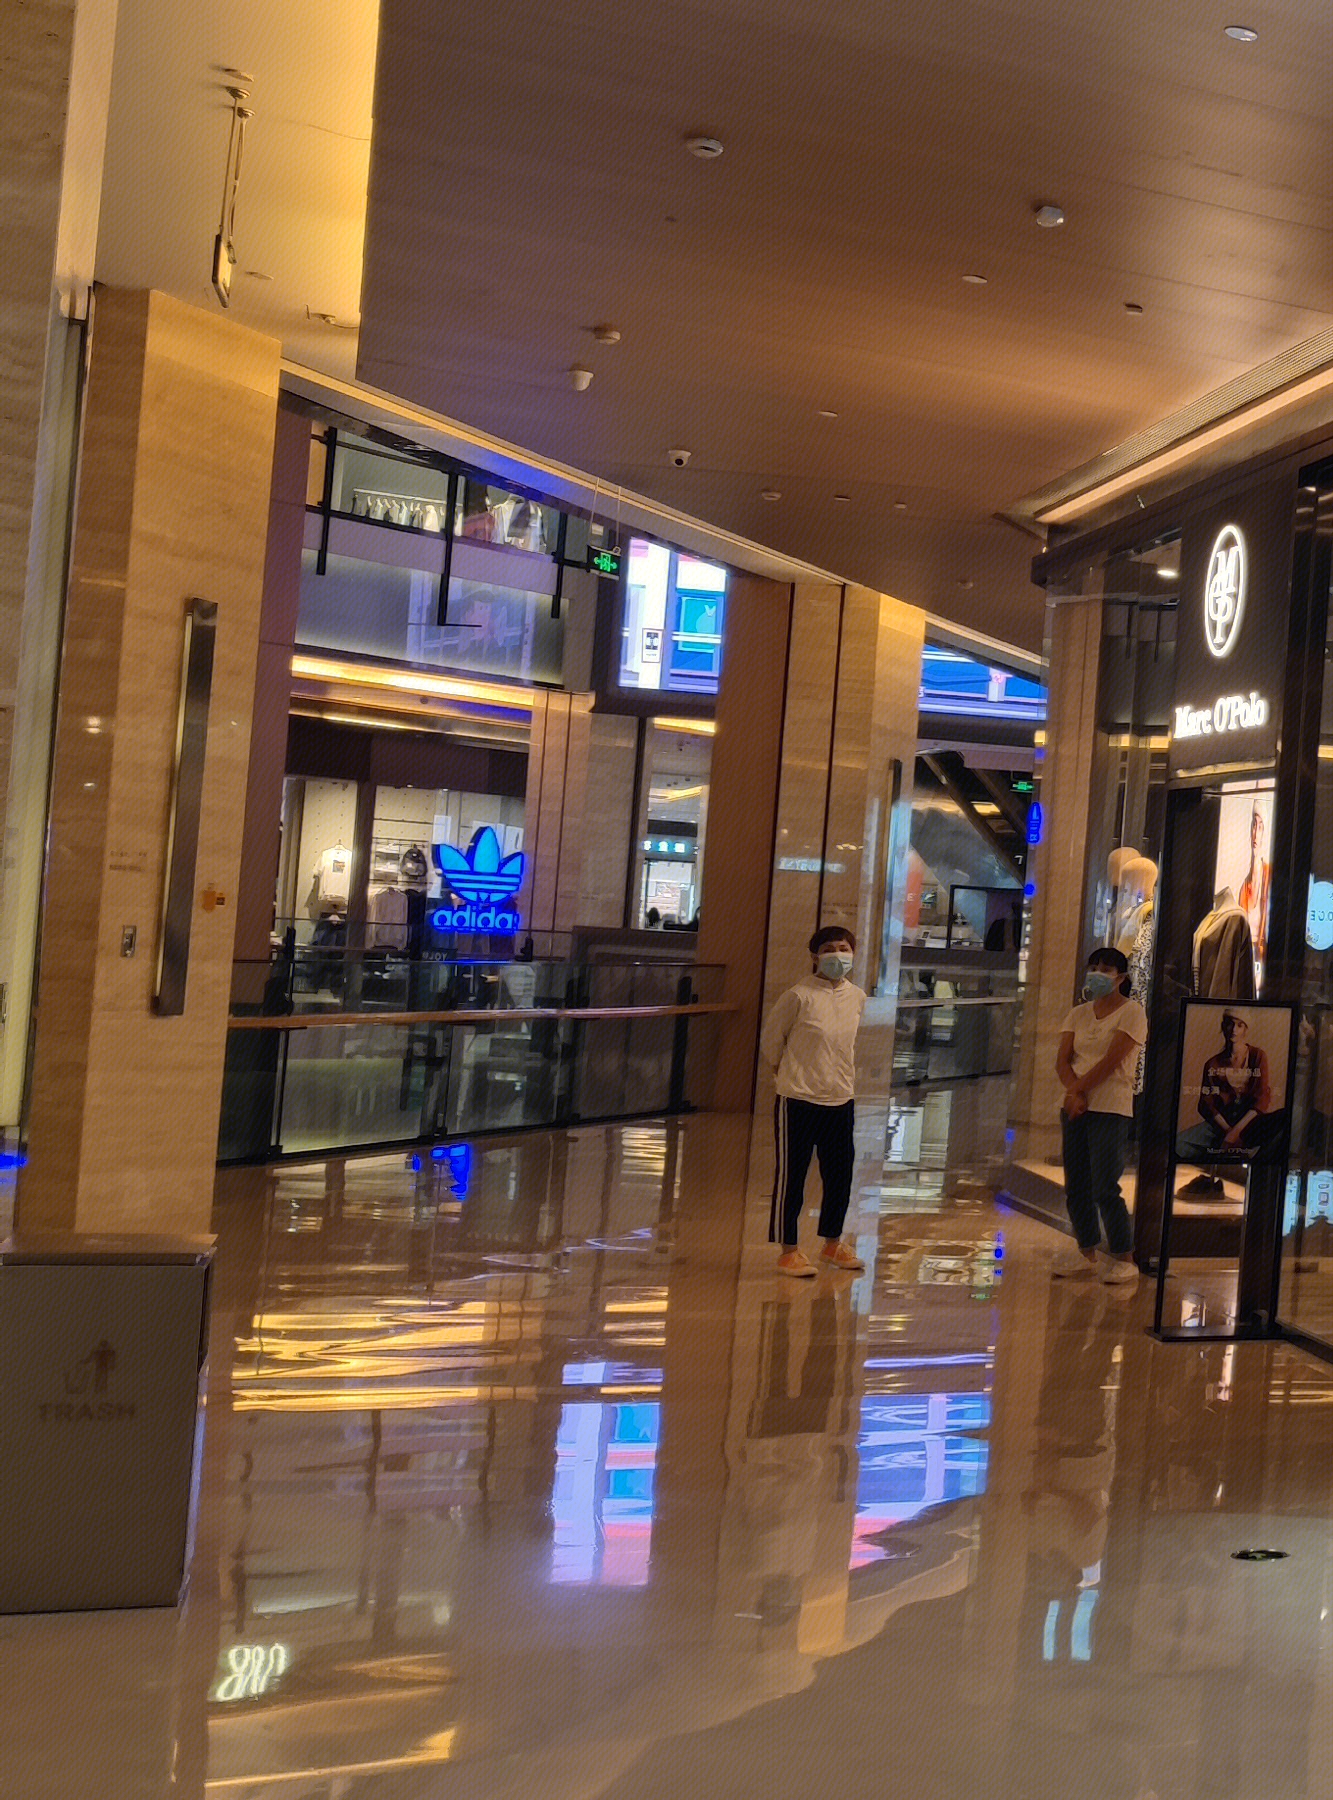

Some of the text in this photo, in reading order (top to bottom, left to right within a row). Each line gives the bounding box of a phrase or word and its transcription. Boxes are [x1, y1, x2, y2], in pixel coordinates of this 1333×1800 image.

[1174, 692, 1266, 739] Marc O'Polo
[38, 1402, 136, 1421] TRASH
